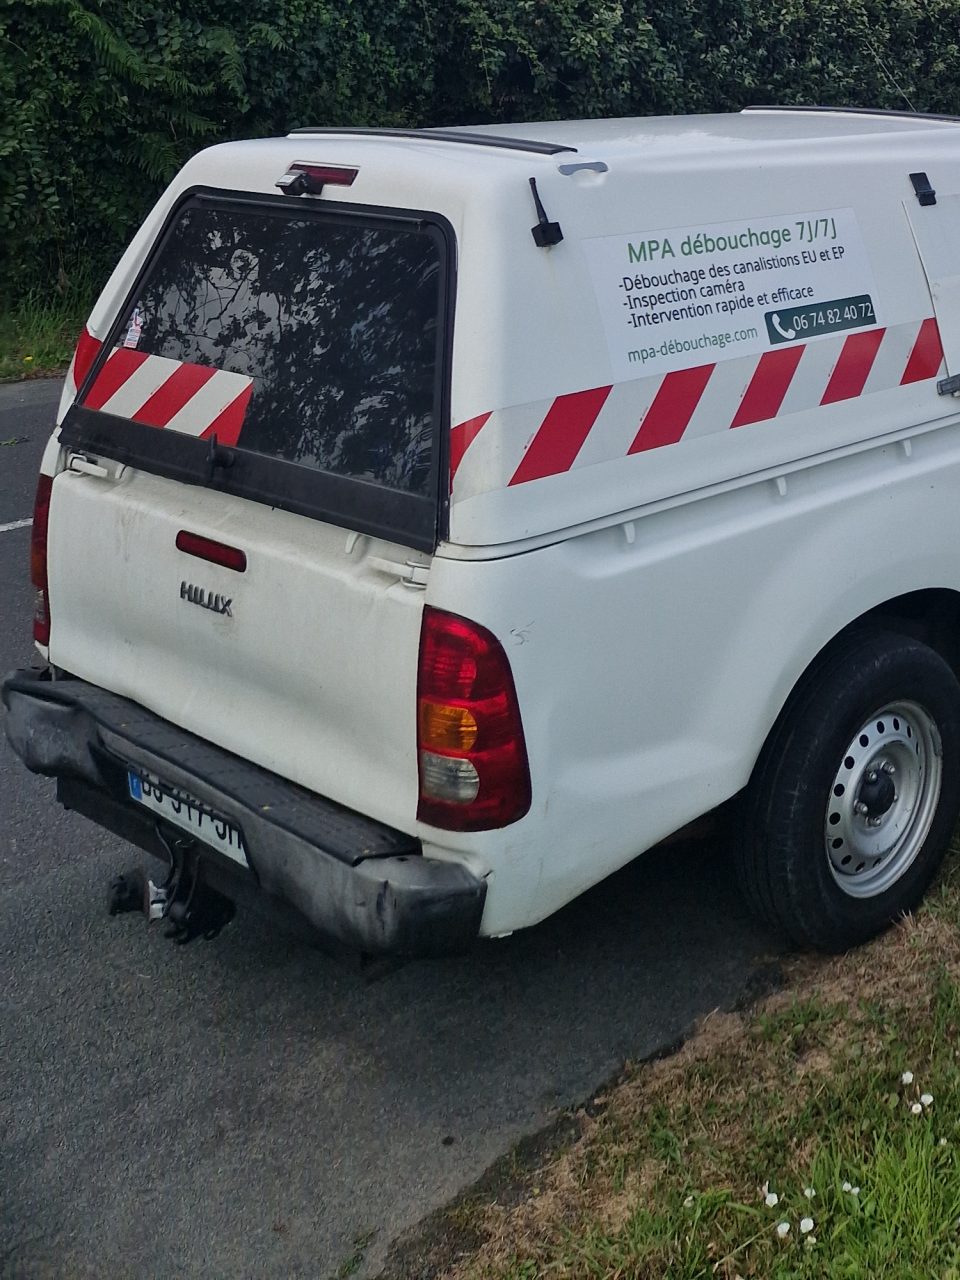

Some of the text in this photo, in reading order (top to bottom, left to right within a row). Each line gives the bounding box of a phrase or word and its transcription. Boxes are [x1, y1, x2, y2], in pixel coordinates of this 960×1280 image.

[627, 218, 837, 264] MPA débouchage 7J/7J
[618, 246, 845, 292] -Débouchage des canalistions EU et EP
[623, 279, 745, 310] -Inspection caméra
[627, 286, 814, 328] -Intervention rapide et efficace
[793, 302, 874, 331] 06 74 82 40 72
[627, 327, 758, 363] mpa-débouchage.com
[180, 581, 232, 617] HILUX
